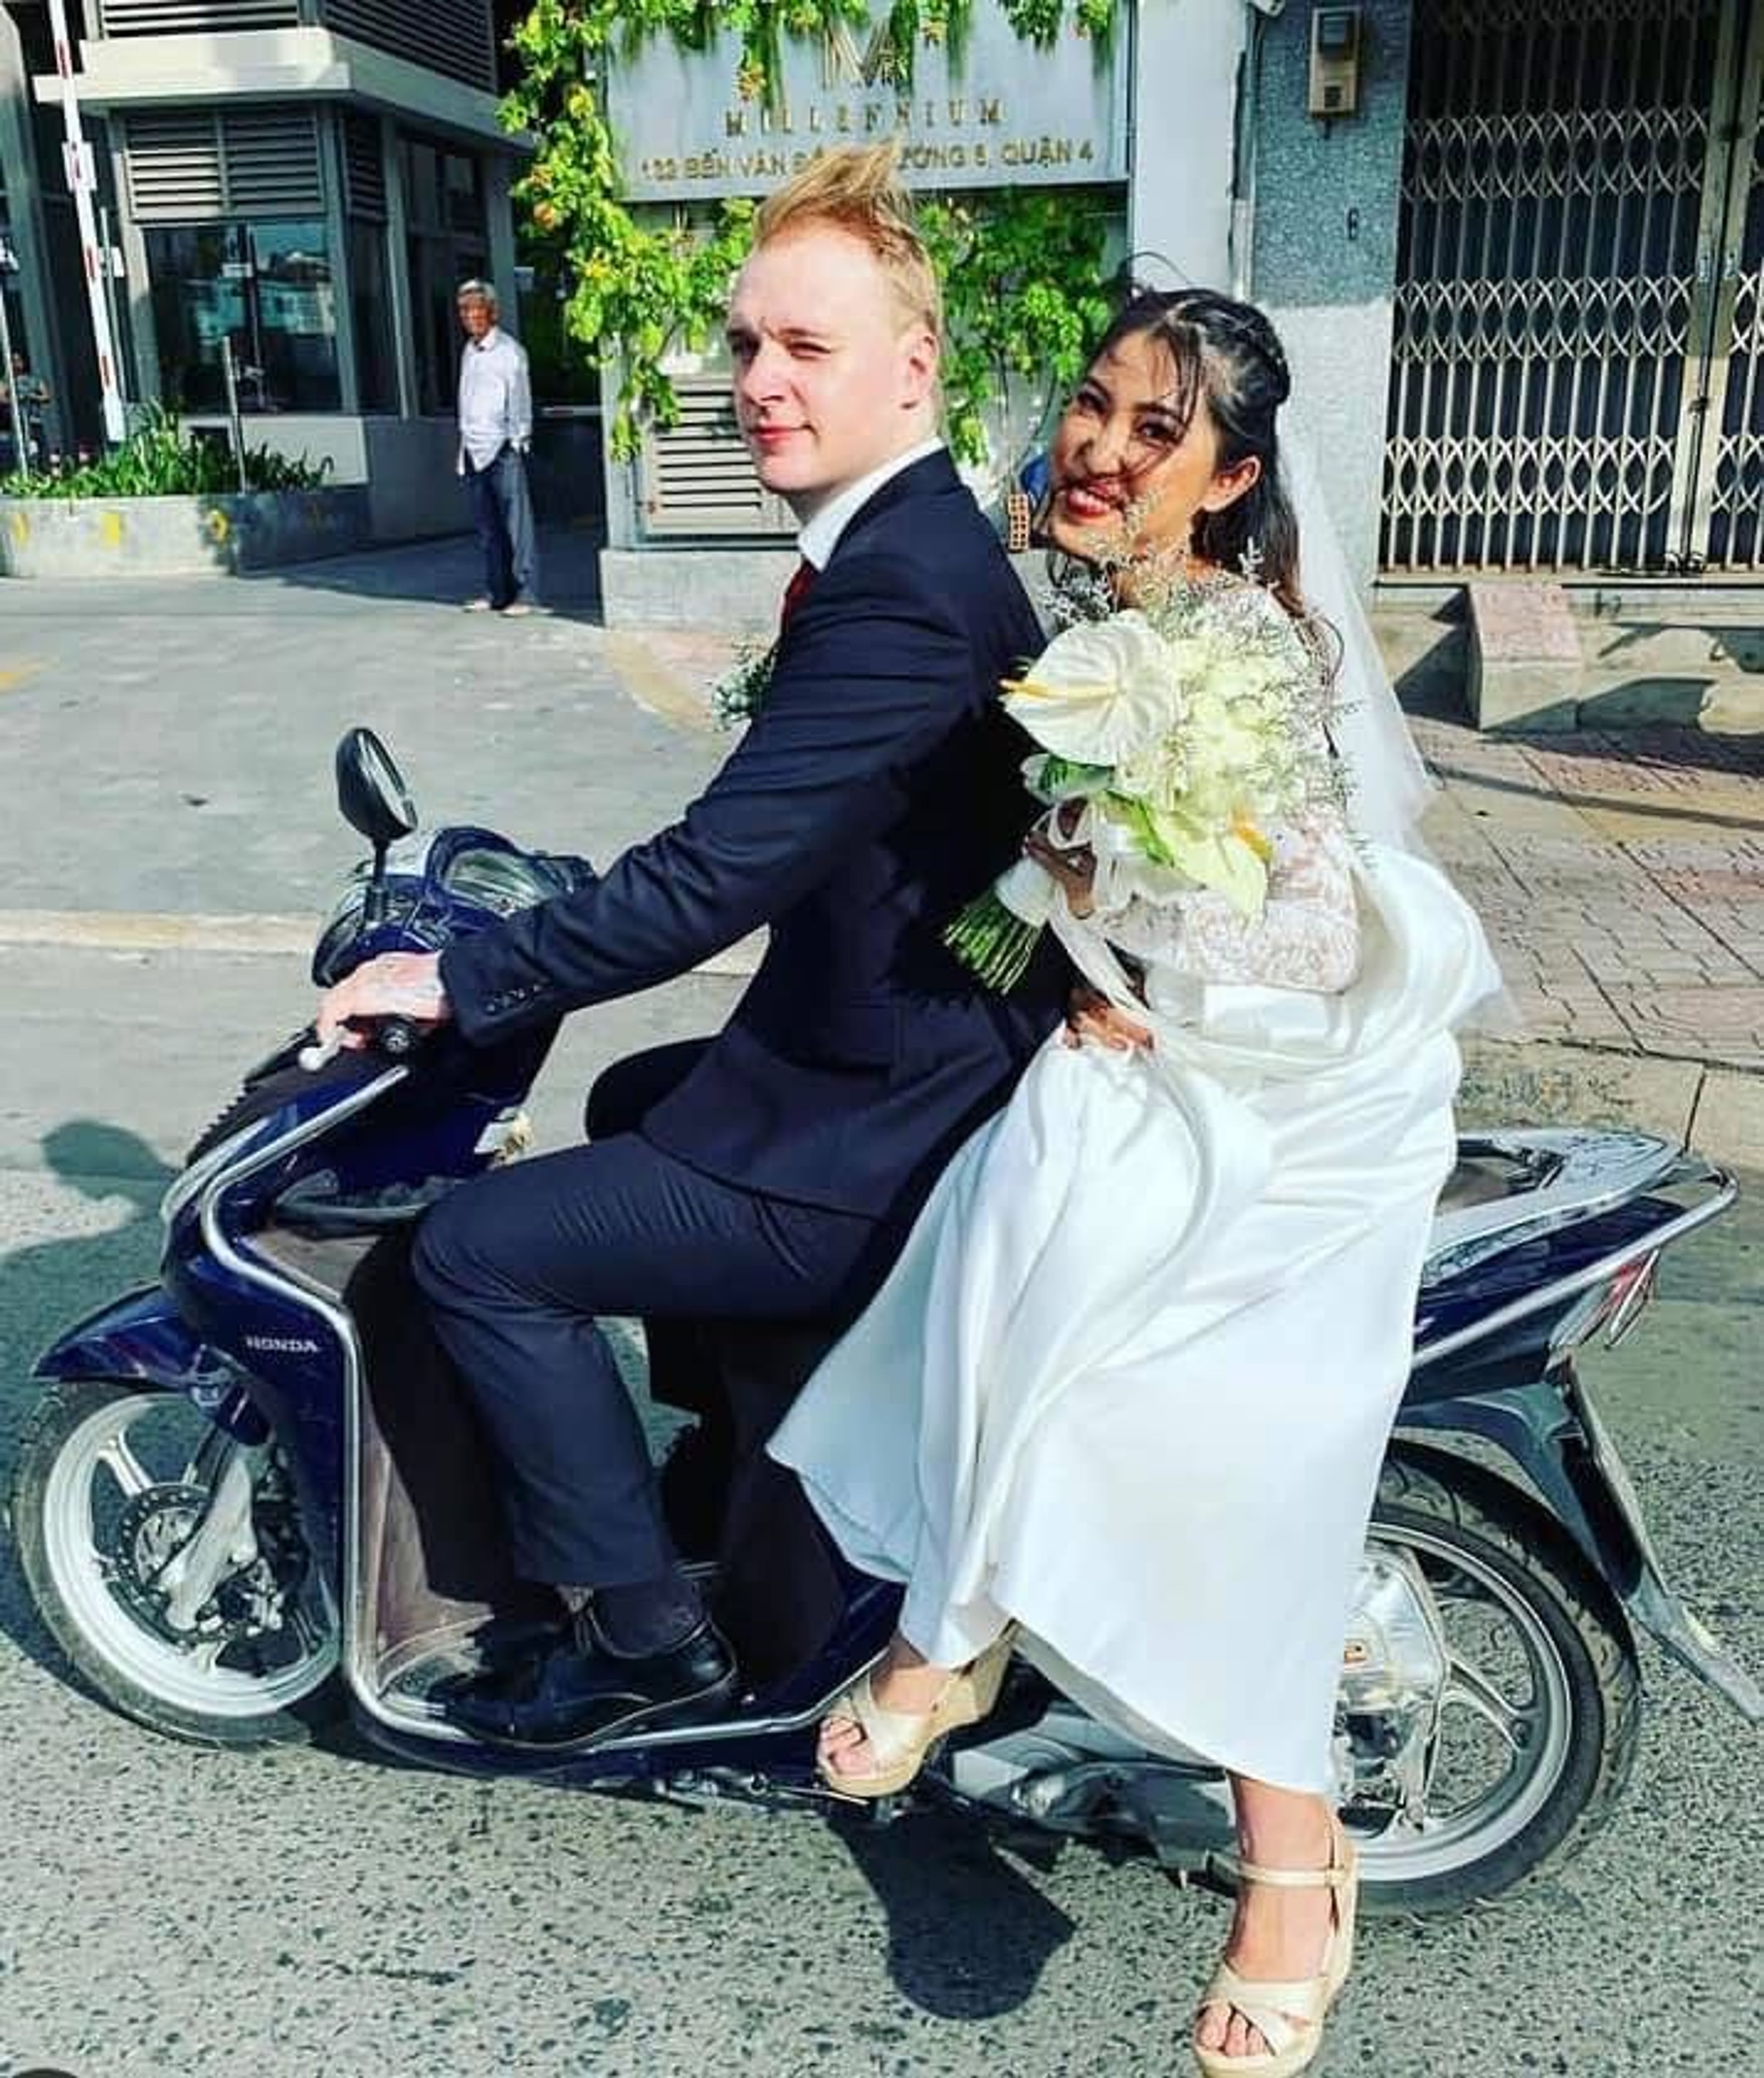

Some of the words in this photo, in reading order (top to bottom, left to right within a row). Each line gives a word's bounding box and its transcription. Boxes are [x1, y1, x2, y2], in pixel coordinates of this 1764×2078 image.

[1000, 136, 1072, 168] QUẬN
[1078, 139, 1094, 164] 4
[244, 1334, 319, 1353] HONDA
